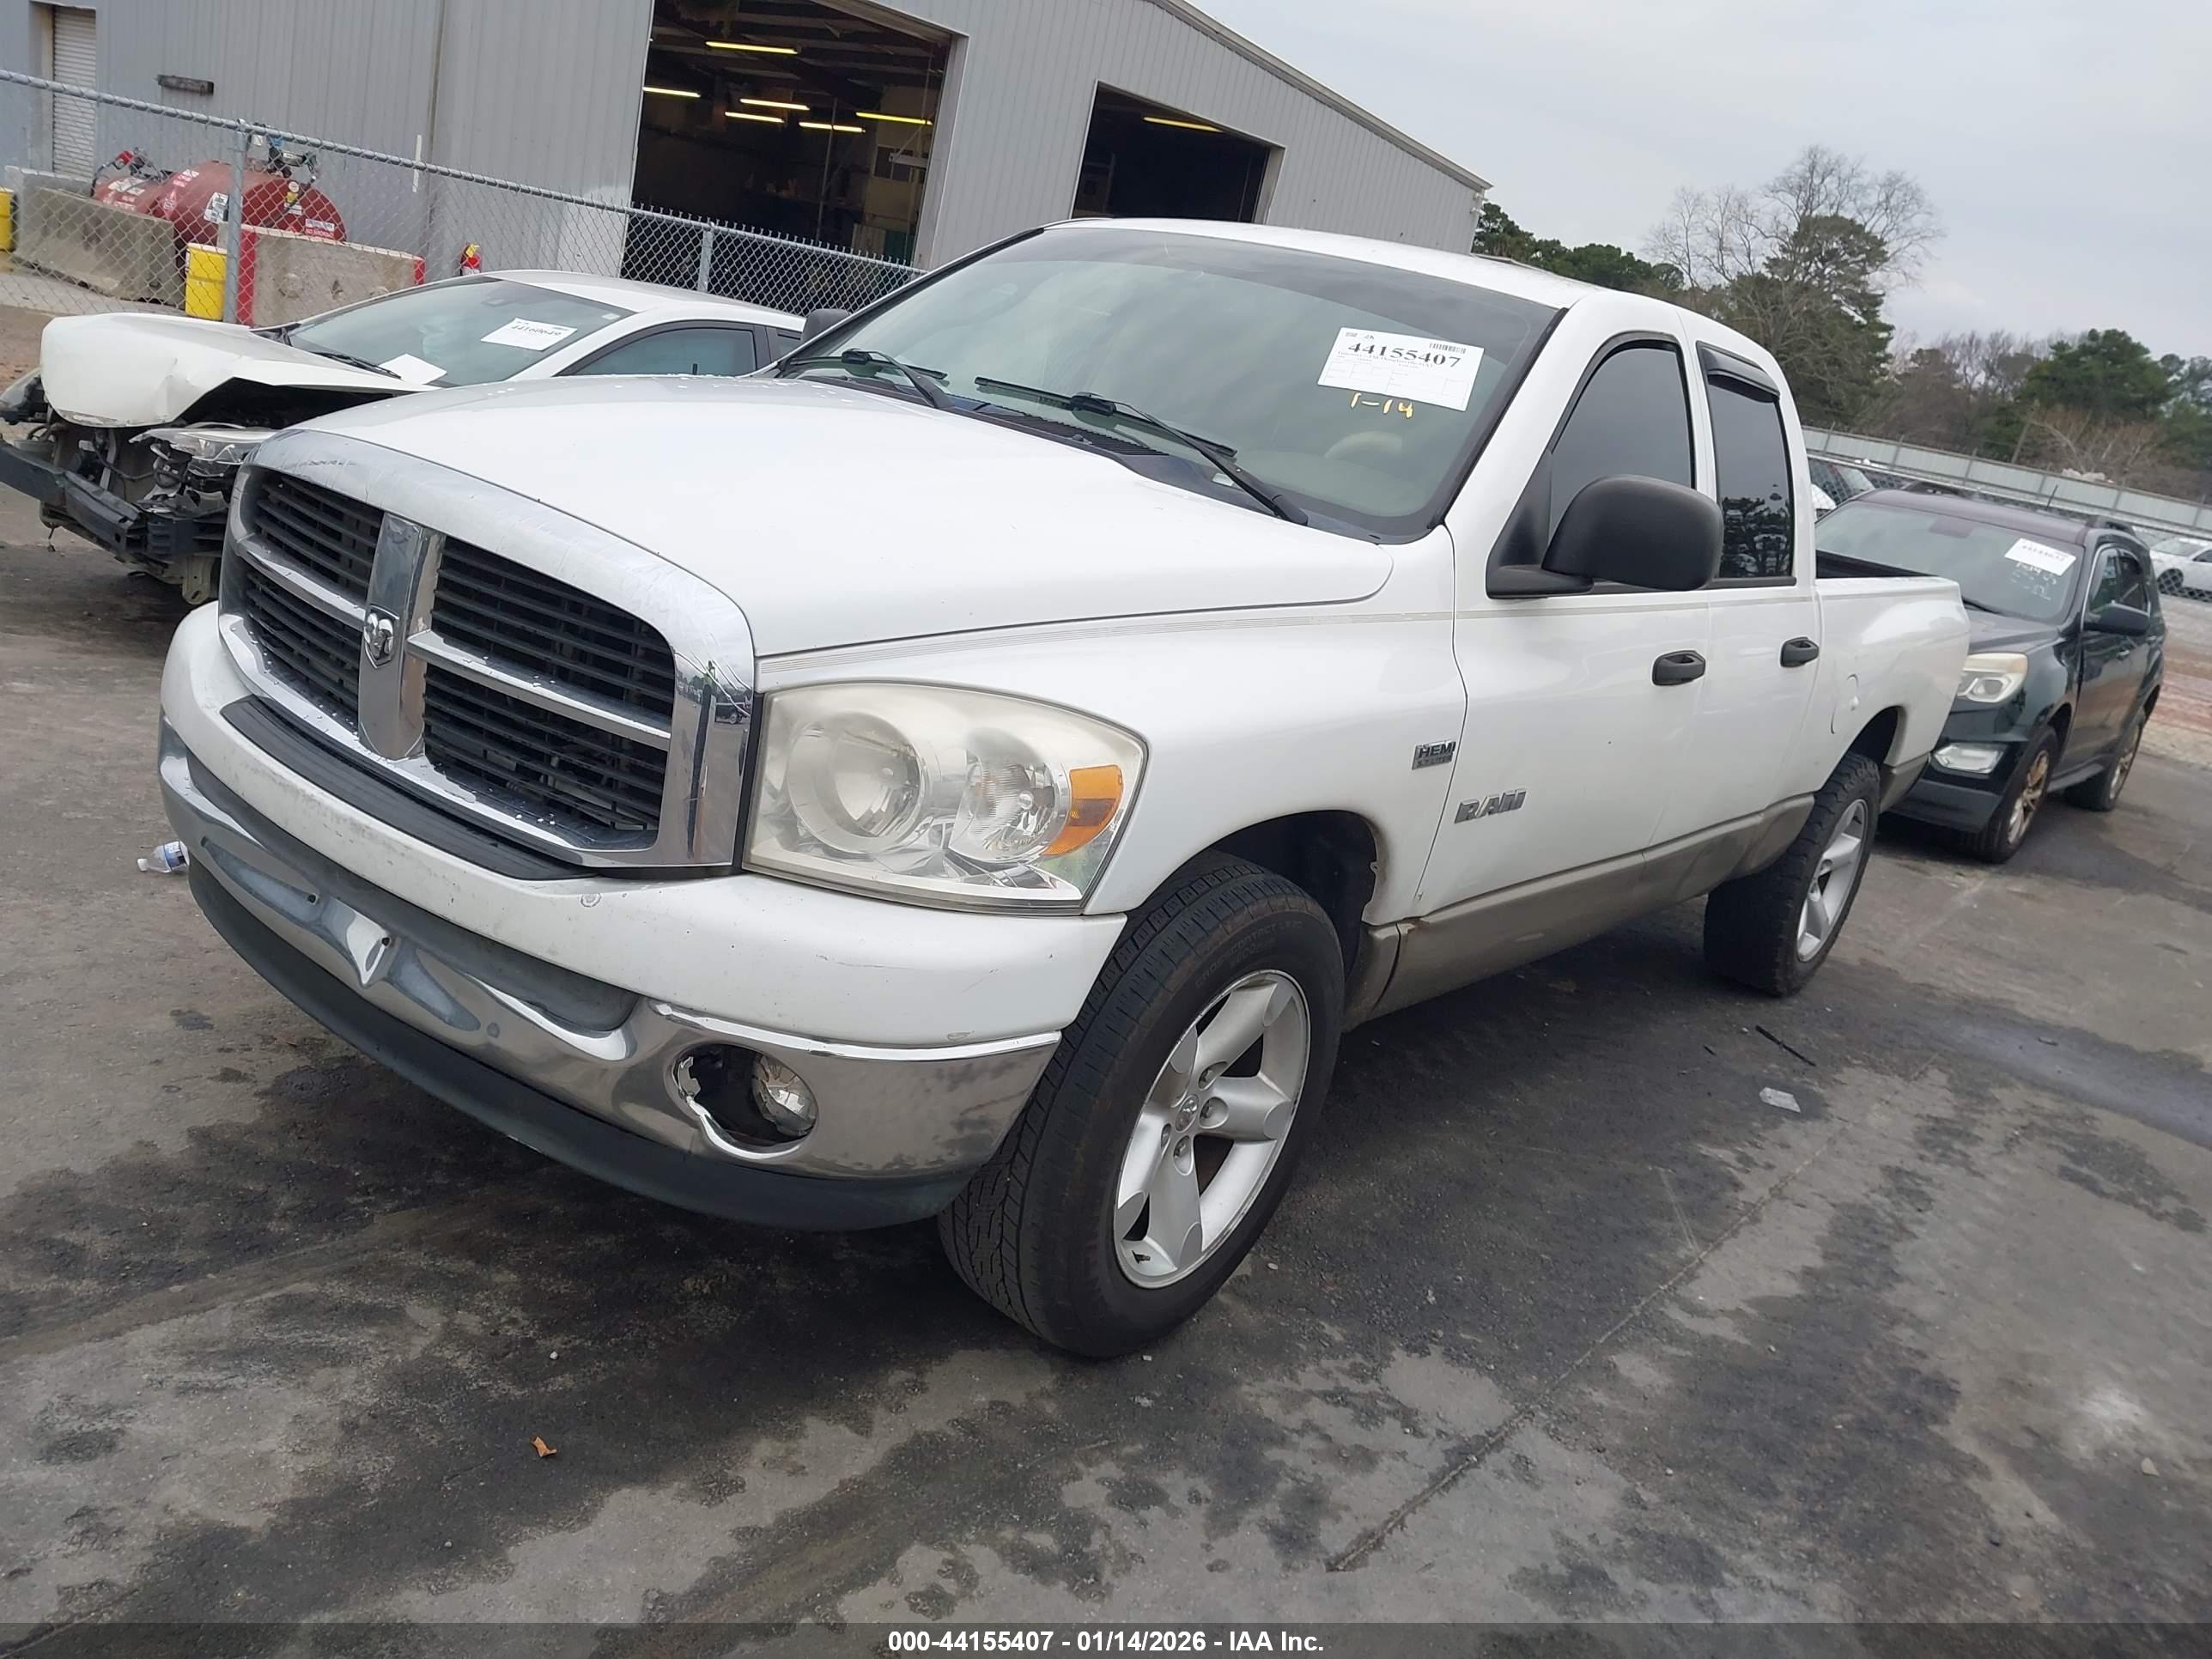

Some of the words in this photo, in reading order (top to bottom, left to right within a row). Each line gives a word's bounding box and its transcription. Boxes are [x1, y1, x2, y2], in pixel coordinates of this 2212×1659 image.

[1348, 342, 1461, 368] 44155407
[1350, 393, 1413, 418] 1-14
[1418, 740, 1456, 759] HEMI
[1455, 788, 1527, 823] RAM
